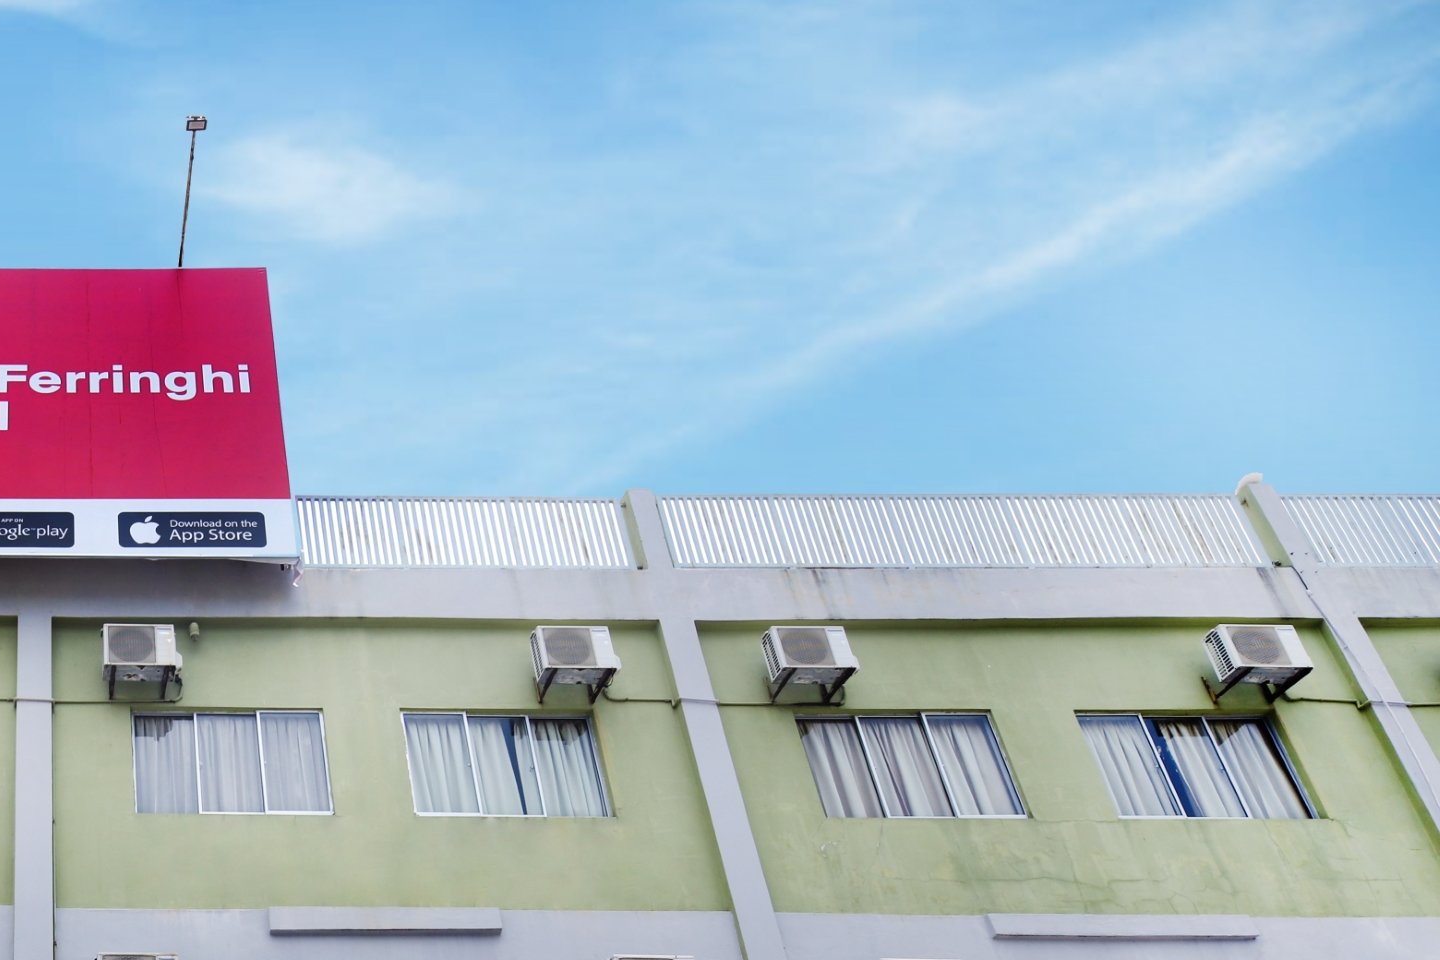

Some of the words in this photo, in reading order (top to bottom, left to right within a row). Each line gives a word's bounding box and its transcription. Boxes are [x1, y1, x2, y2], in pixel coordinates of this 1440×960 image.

[169, 519, 222, 528] Download
[240, 519, 258, 528] the
[36, 524, 69, 540] play
[169, 528, 204, 543] App
[208, 528, 253, 541] Store
